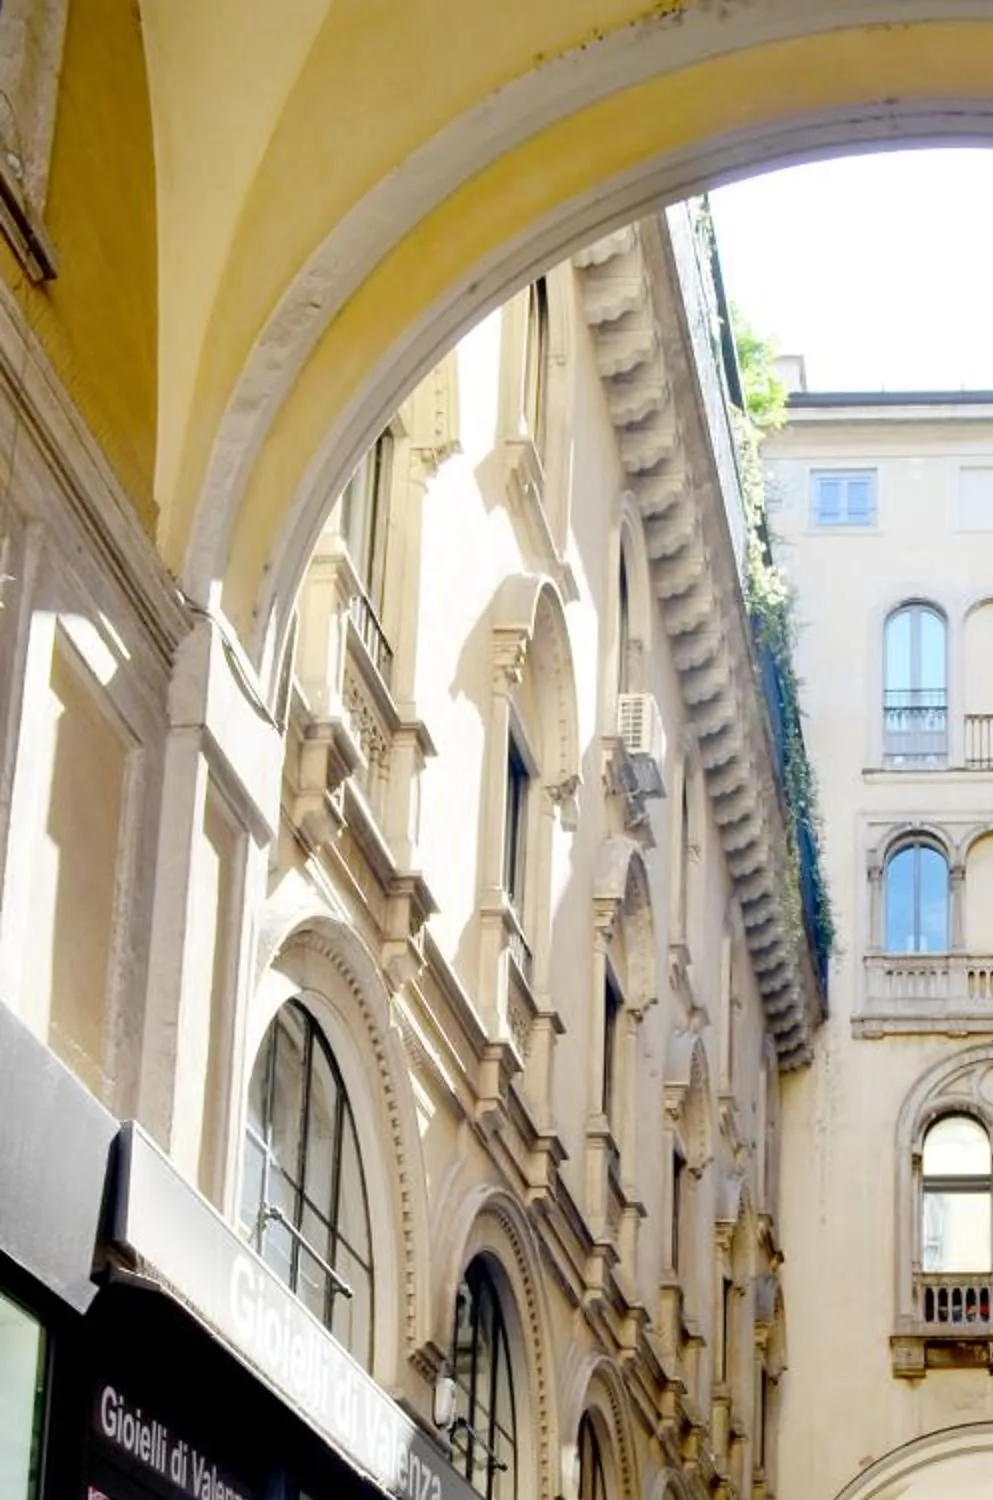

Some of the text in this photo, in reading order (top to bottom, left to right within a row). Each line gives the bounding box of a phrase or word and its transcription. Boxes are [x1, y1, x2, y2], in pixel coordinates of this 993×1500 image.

[231, 1254, 330, 1415] Gioielli
[101, 1385, 167, 1473] Gioielli
[171, 1440, 188, 1488] di
